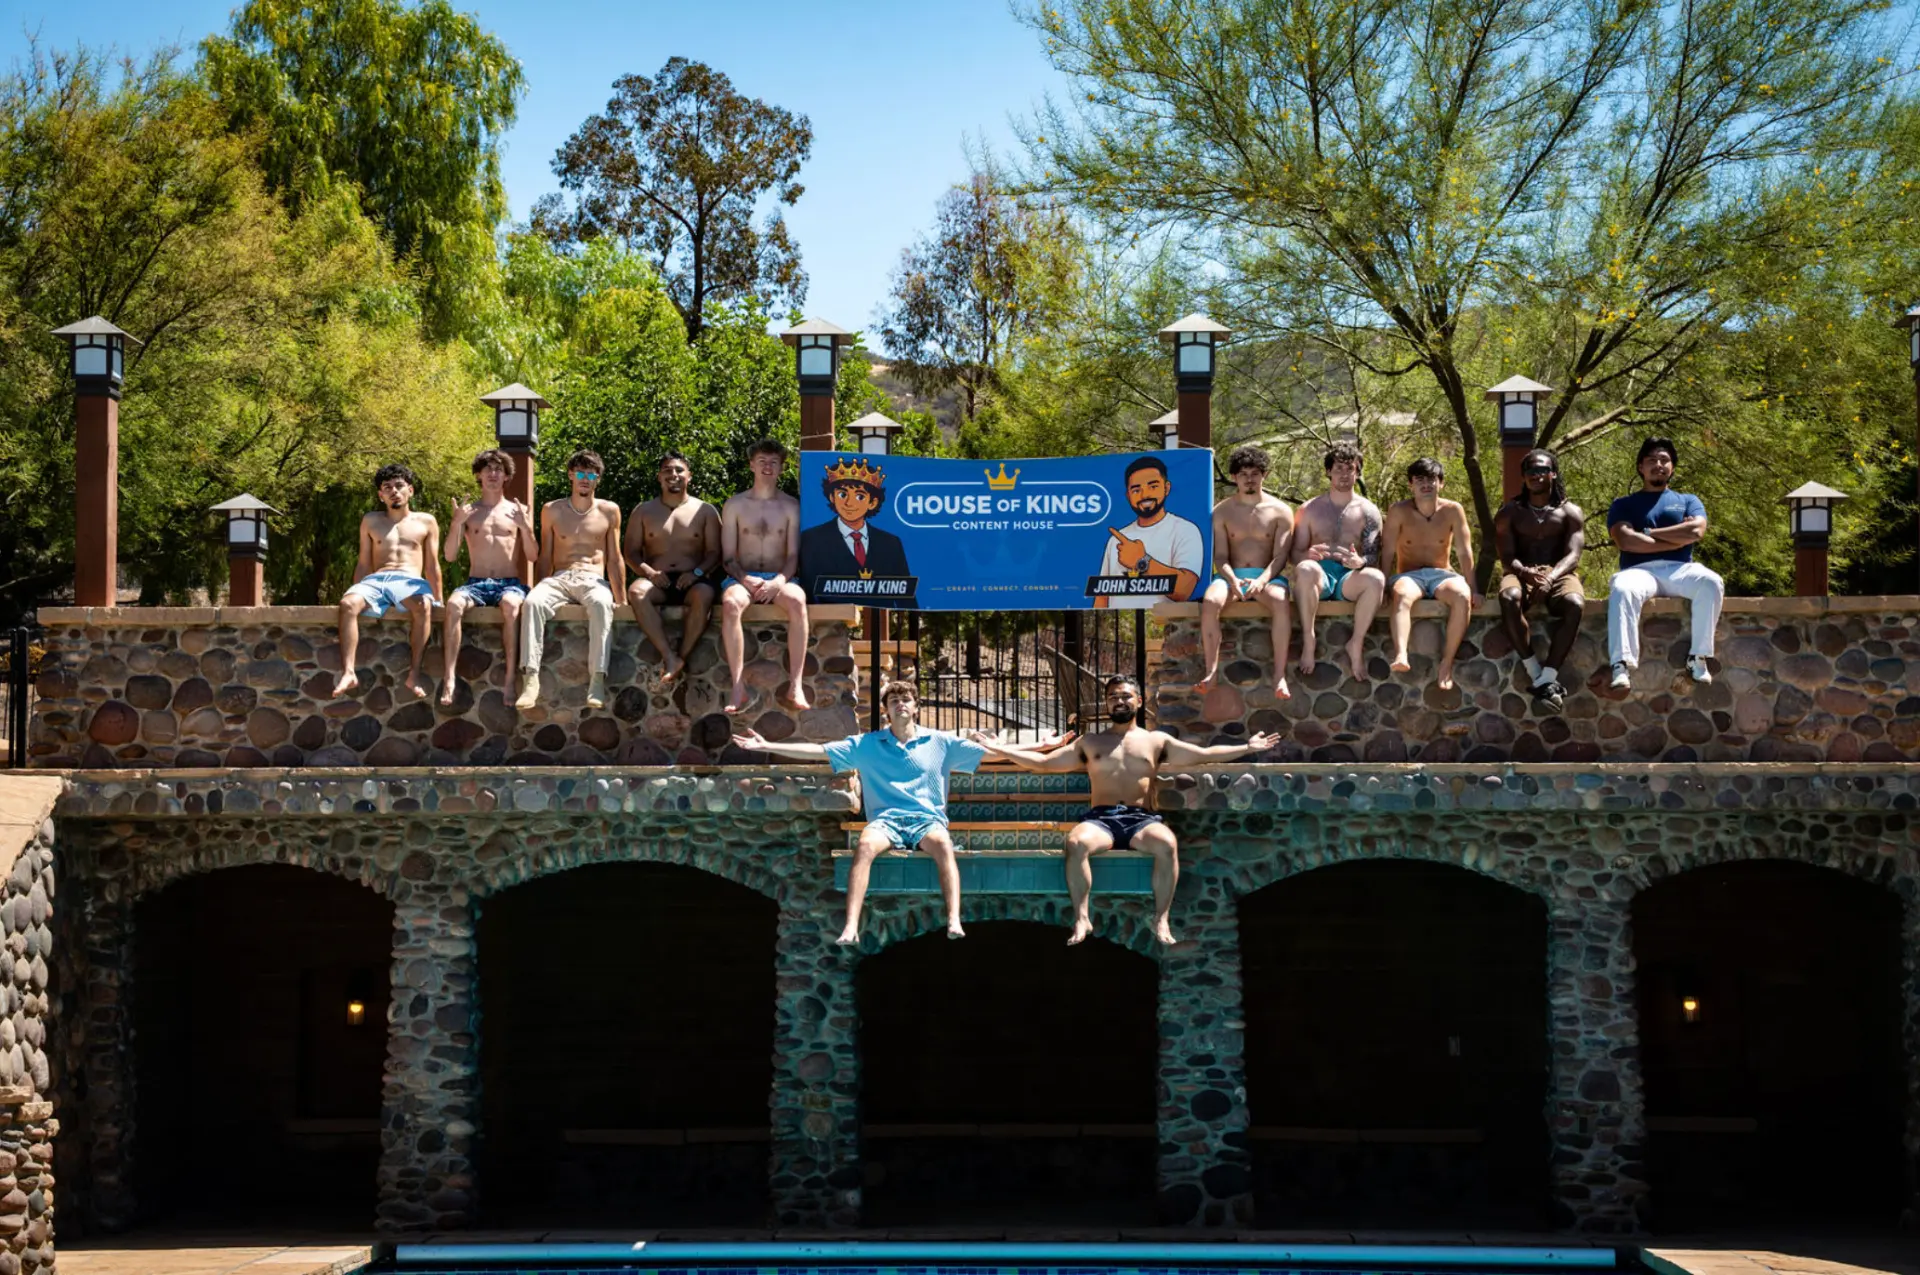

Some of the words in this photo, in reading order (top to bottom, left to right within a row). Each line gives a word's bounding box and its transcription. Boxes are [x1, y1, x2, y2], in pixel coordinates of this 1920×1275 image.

[907, 495, 992, 514] HOUSE
[997, 499, 1020, 512] OF
[1026, 494, 1101, 514] KINGS
[952, 521, 1009, 531] CONTENT
[1013, 520, 1054, 530] HOUSE
[823, 579, 875, 593] ANDREW
[877, 580, 907, 594] KING
[1093, 579, 1127, 593] JOHN
[1129, 578, 1169, 592] SCALIA
